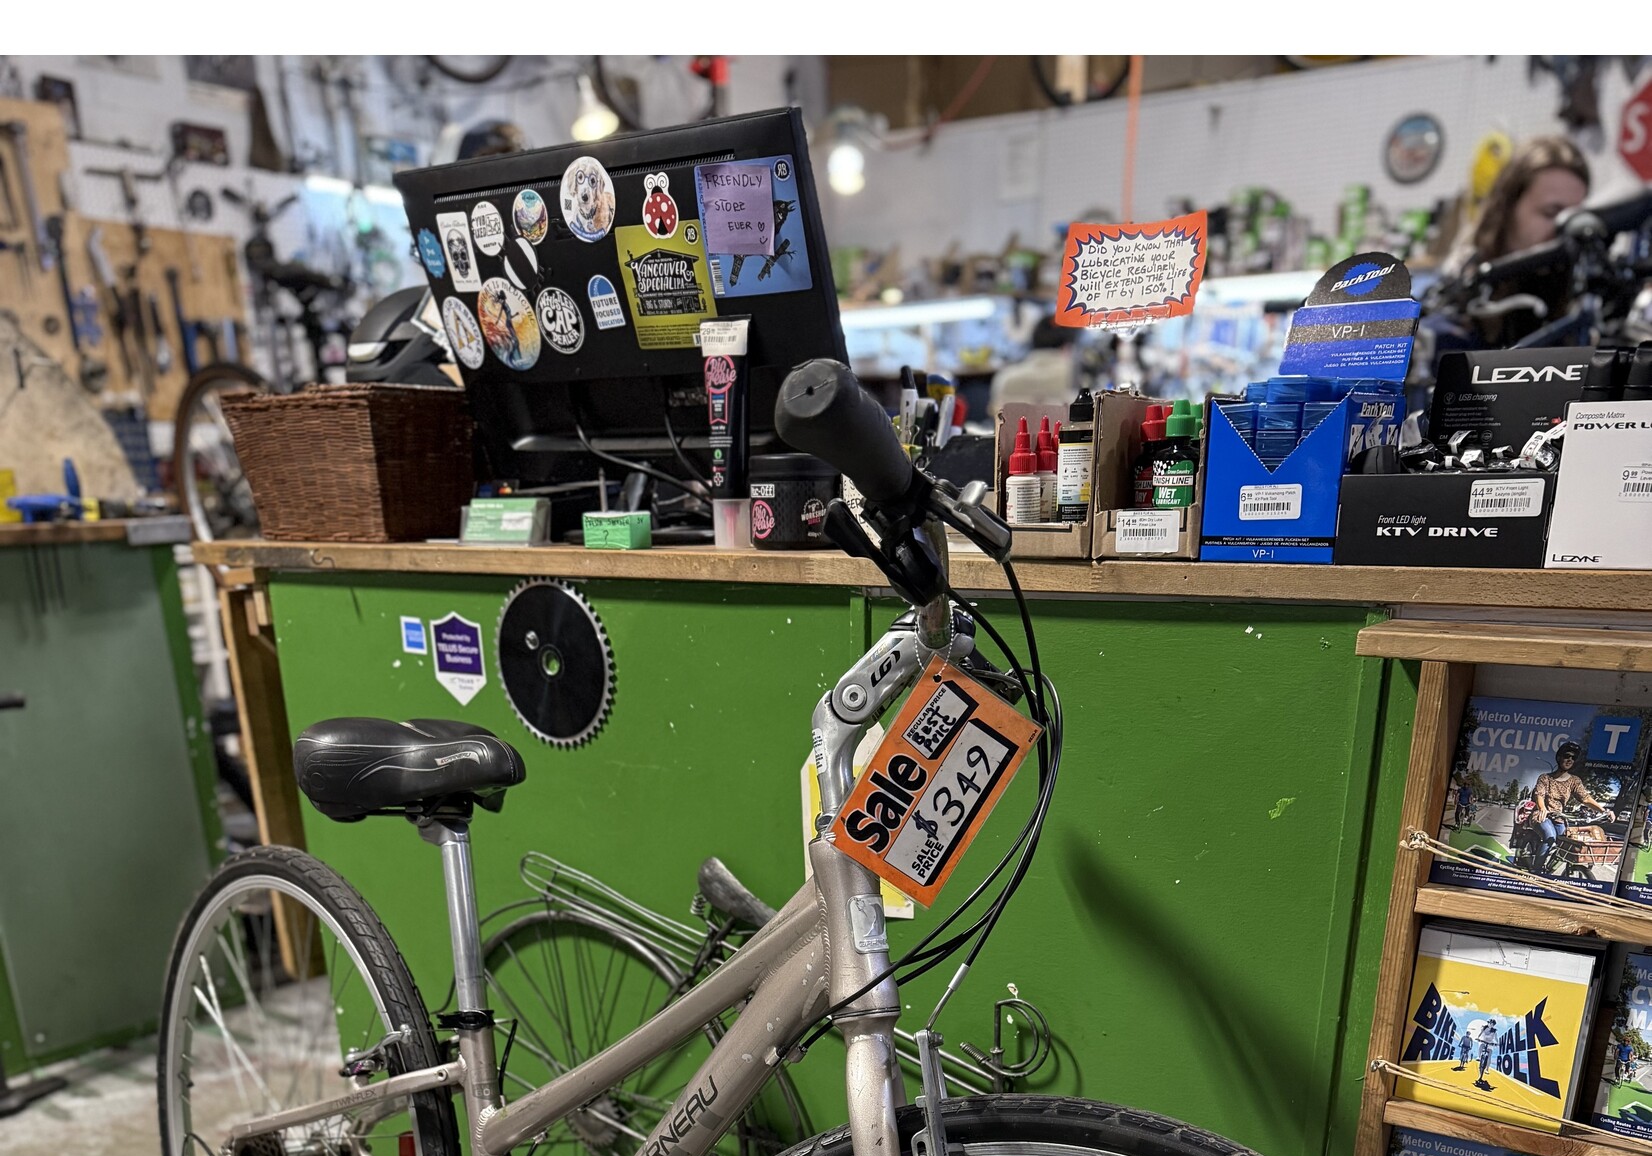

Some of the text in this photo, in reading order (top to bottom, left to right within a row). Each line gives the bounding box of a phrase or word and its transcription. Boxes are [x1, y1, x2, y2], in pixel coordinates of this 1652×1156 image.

[704, 173, 763, 189] FRIENDLY
[715, 199, 746, 212] STORE
[1112, 244, 1131, 255] YOU
[1133, 242, 1161, 253] KNOW
[1164, 238, 1185, 249] THAT
[1151, 251, 1175, 265] YOUR
[631, 255, 694, 281] VANCOUVER
[1146, 272, 1164, 284] THE
[1087, 292, 1101, 302] OF
[1107, 289, 1118, 300] IT
[592, 297, 618, 310] FUTURE
[542, 307, 577, 334] CAP
[595, 308, 621, 319] FOCUSED
[552, 329, 580, 347] DEALER
[1471, 364, 1584, 385] LEZYNE
[1472, 393, 1498, 402] charging
[1575, 412, 1606, 420] Composite
[1573, 421, 1637, 430] POWER
[1172, 476, 1189, 484] LINE
[1622, 469, 1630, 481] 9
[1159, 487, 1177, 499] WET
[1241, 493, 1246, 502] 6
[1472, 487, 1485, 497] 44
[1122, 519, 1131, 527] 14
[1377, 515, 1427, 525] Front LED light
[1376, 527, 1499, 537] KTV DRIVE
[1552, 554, 1600, 563] LEZYNE
[907, 687, 947, 739] REGULAR PRICE
[1477, 710, 1574, 729] Metro Vancouver
[1471, 727, 1571, 753] CYCLING
[1603, 724, 1631, 754] T
[1467, 751, 1519, 774] MAP
[845, 753, 929, 854] Sale
[911, 838, 935, 870] SALE
[917, 842, 945, 878] PRICE
[1439, 864, 1455, 873] Cycling
[1413, 982, 1457, 1042] BIKE
[1499, 996, 1559, 1055] WALK
[1402, 1026, 1456, 1061] RIDE
[1497, 1050, 1561, 1099] ROLL
[1402, 1134, 1432, 1149] Metro
